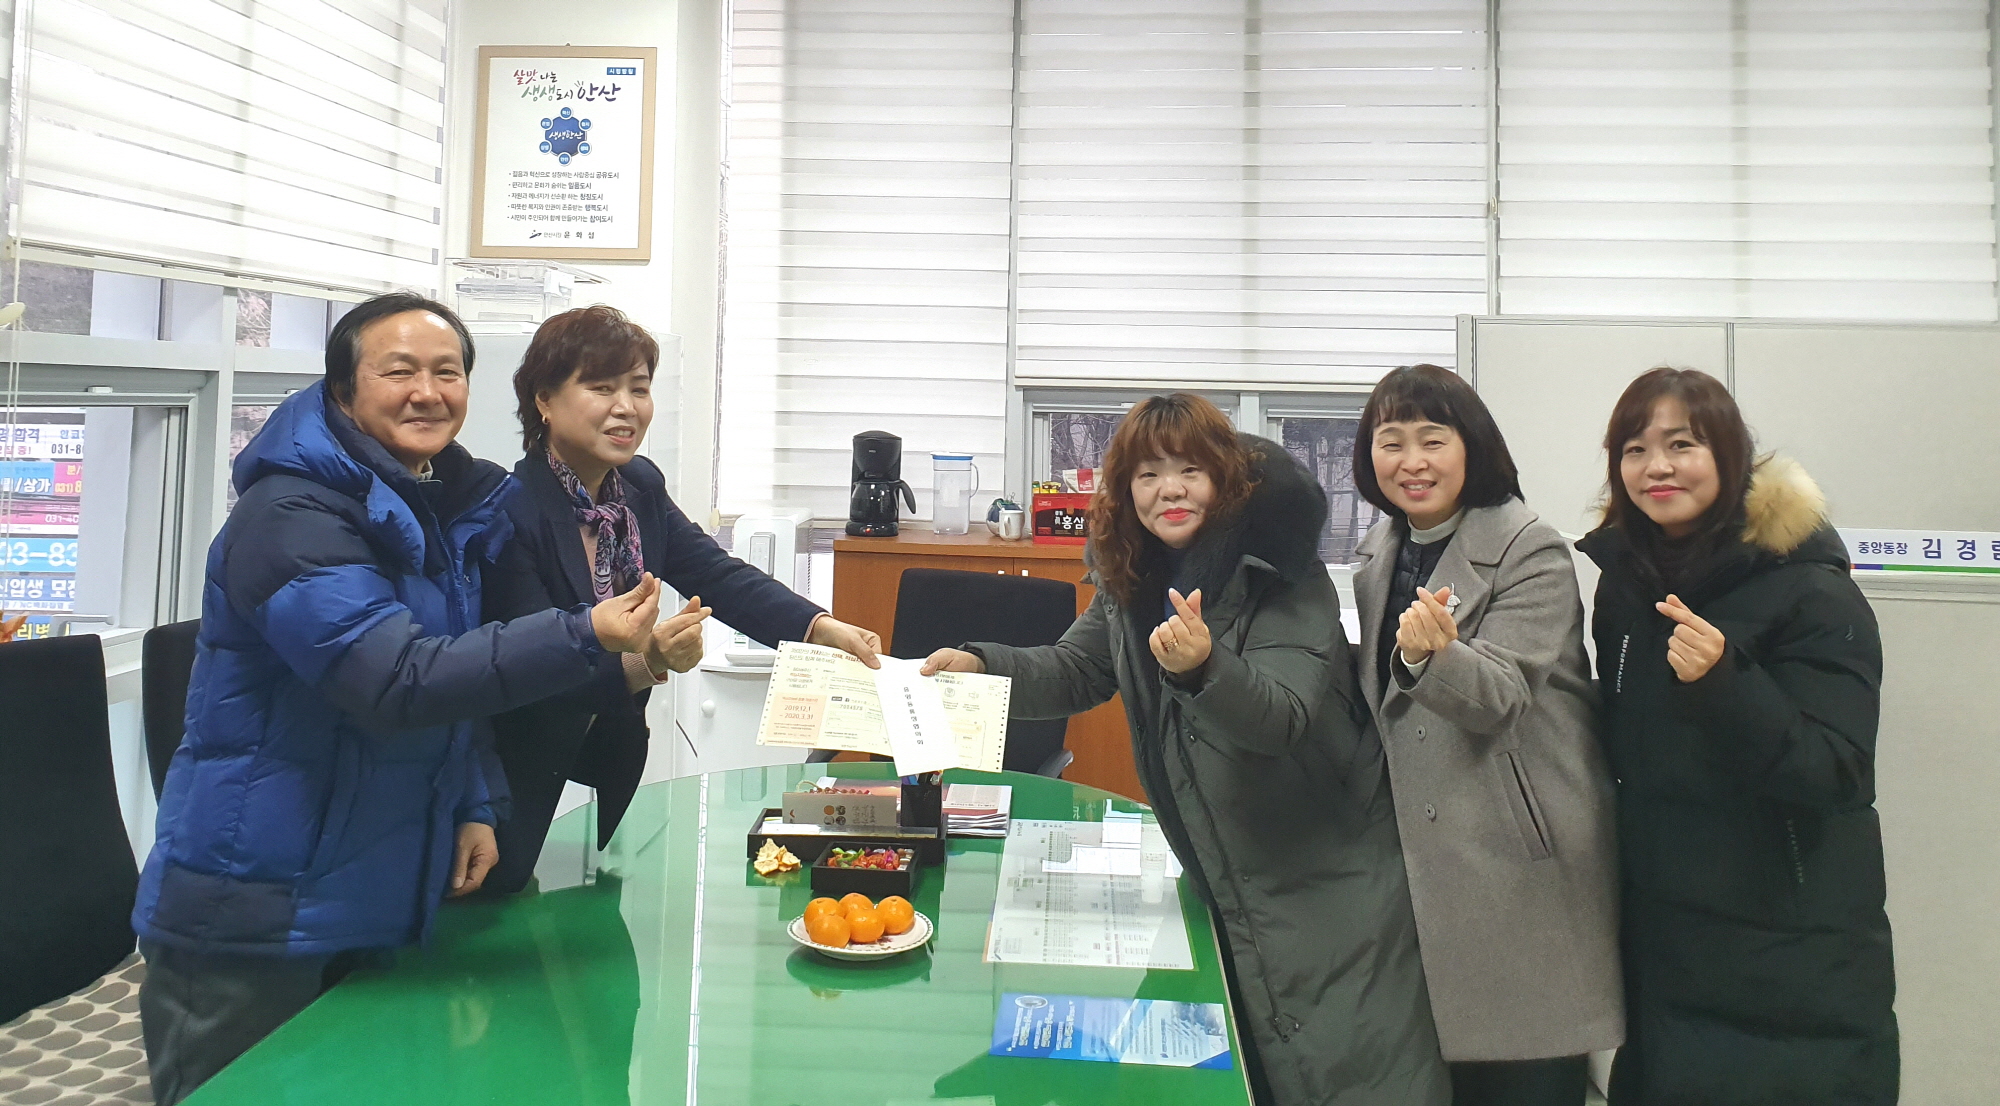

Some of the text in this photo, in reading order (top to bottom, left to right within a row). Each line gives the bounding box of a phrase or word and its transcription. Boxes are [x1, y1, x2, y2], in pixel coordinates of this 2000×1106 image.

[513, 69, 538, 85] 살맛
[577, 82, 621, 102] 안산
[1062, 515, 1085, 530] 홍삼
[1858, 541, 1909, 555] 중앙동장
[1616, 634, 1630, 693] PERFORMANCE
